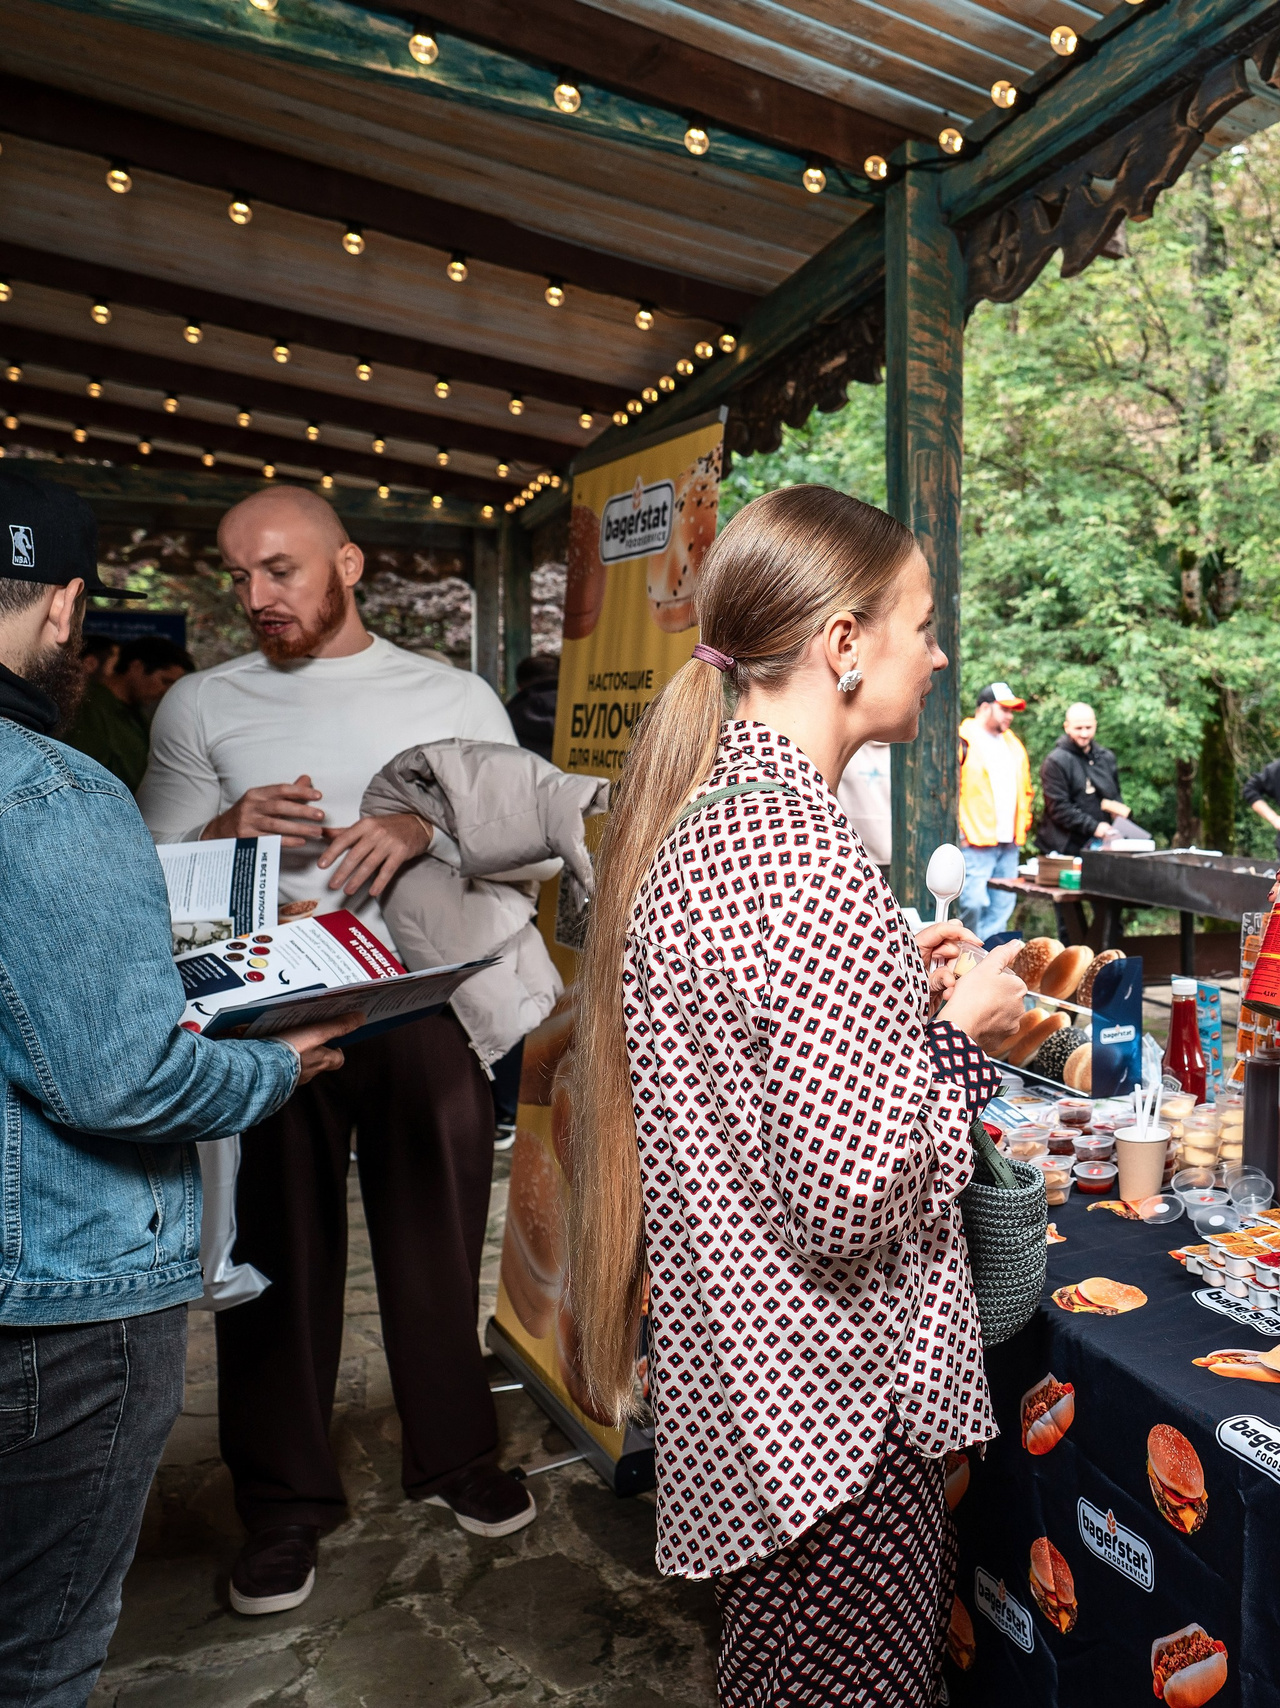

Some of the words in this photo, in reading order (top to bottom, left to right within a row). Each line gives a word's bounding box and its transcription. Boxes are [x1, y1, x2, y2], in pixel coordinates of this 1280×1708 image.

[605, 501, 668, 544] bagerstat
[14, 556, 28, 565] NBA
[587, 670, 654, 692] НАСТОЯЩИЕ
[1082, 1509, 1149, 1574] bagerstat
[1104, 1549, 1149, 1585] FOODSERVICE
[978, 1577, 1028, 1638] bagerstat
